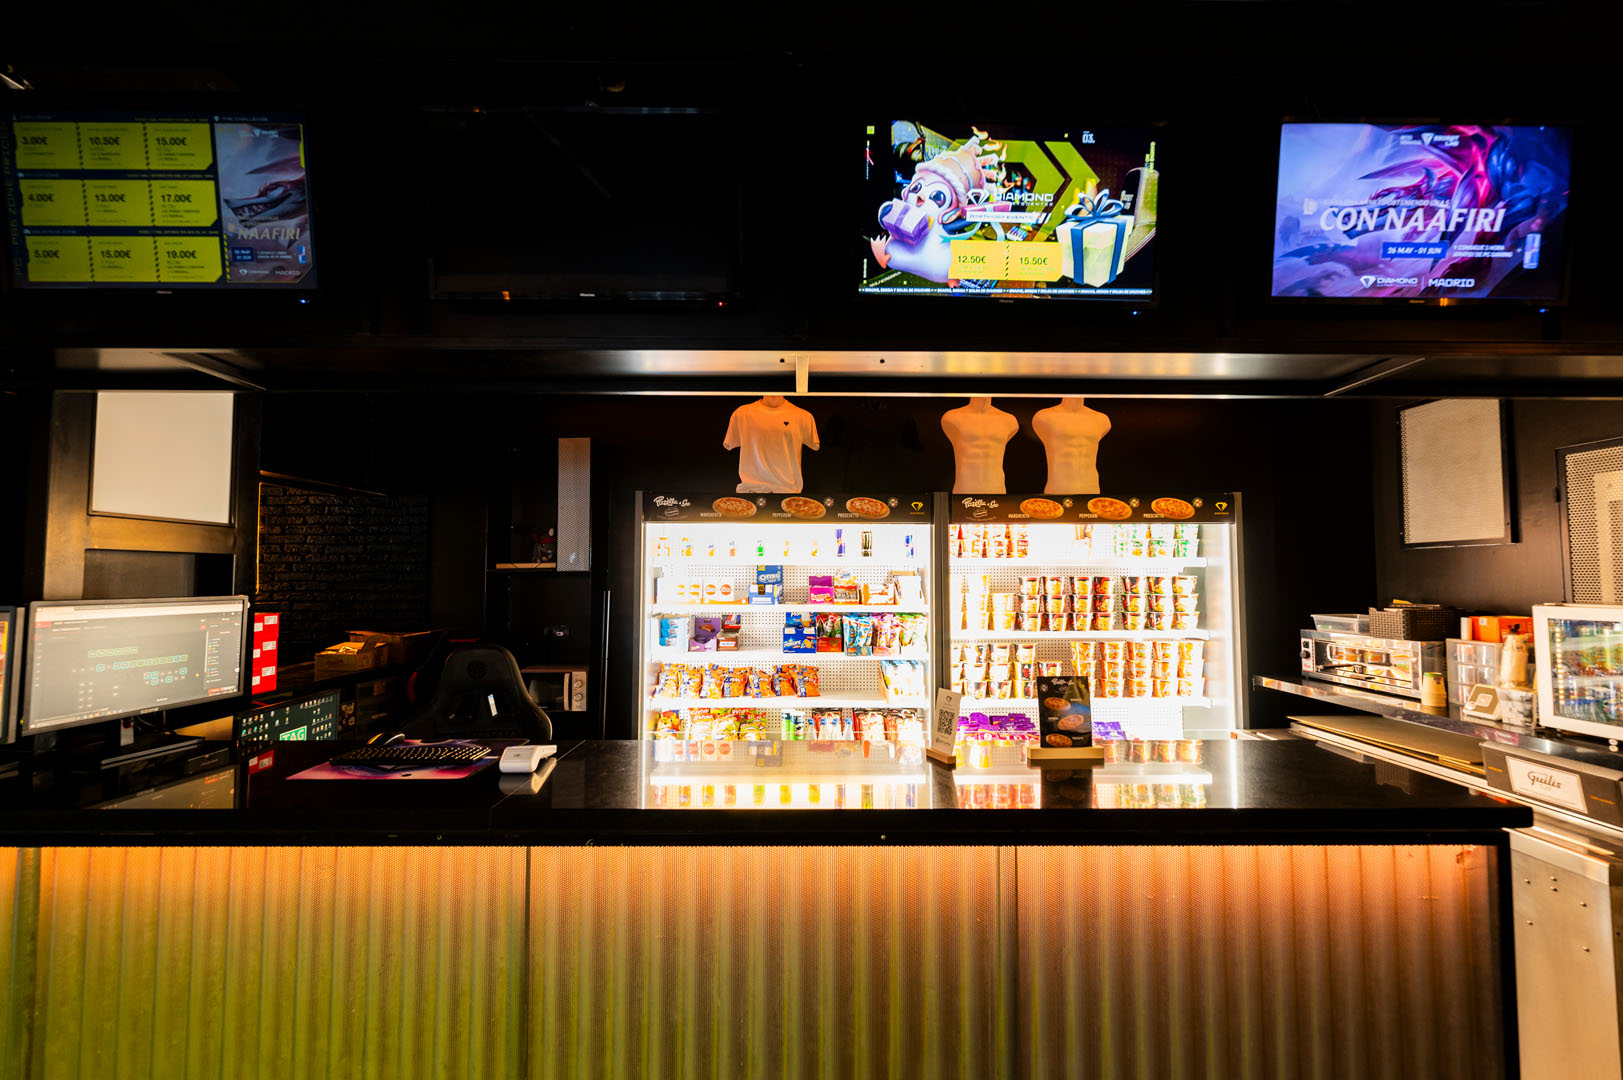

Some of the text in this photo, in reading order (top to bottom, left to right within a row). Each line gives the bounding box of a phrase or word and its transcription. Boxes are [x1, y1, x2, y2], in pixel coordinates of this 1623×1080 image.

[22, 136, 48, 145] 3.00€
[89, 136, 120, 146] 10.50€
[156, 136, 187, 146] 15.00€
[28, 193, 54, 202] 4.00€
[95, 193, 126, 202] 13.00€
[161, 193, 192, 203] 17.00€
[995, 192, 1054, 202] DIAMOND
[1320, 207, 1507, 232] CON NAAFIRI
[237, 227, 300, 240] NAAFIRI
[34, 250, 60, 259] 5.00€
[100, 250, 131, 259] 15.00€
[166, 250, 197, 259] 19.00€
[1427, 247, 1442, 255] JUN
[957, 256, 987, 264] 12.50€
[1019, 257, 1048, 265] 15.50€
[1428, 278, 1475, 287] MADRID
[282, 728, 304, 741] TAG
